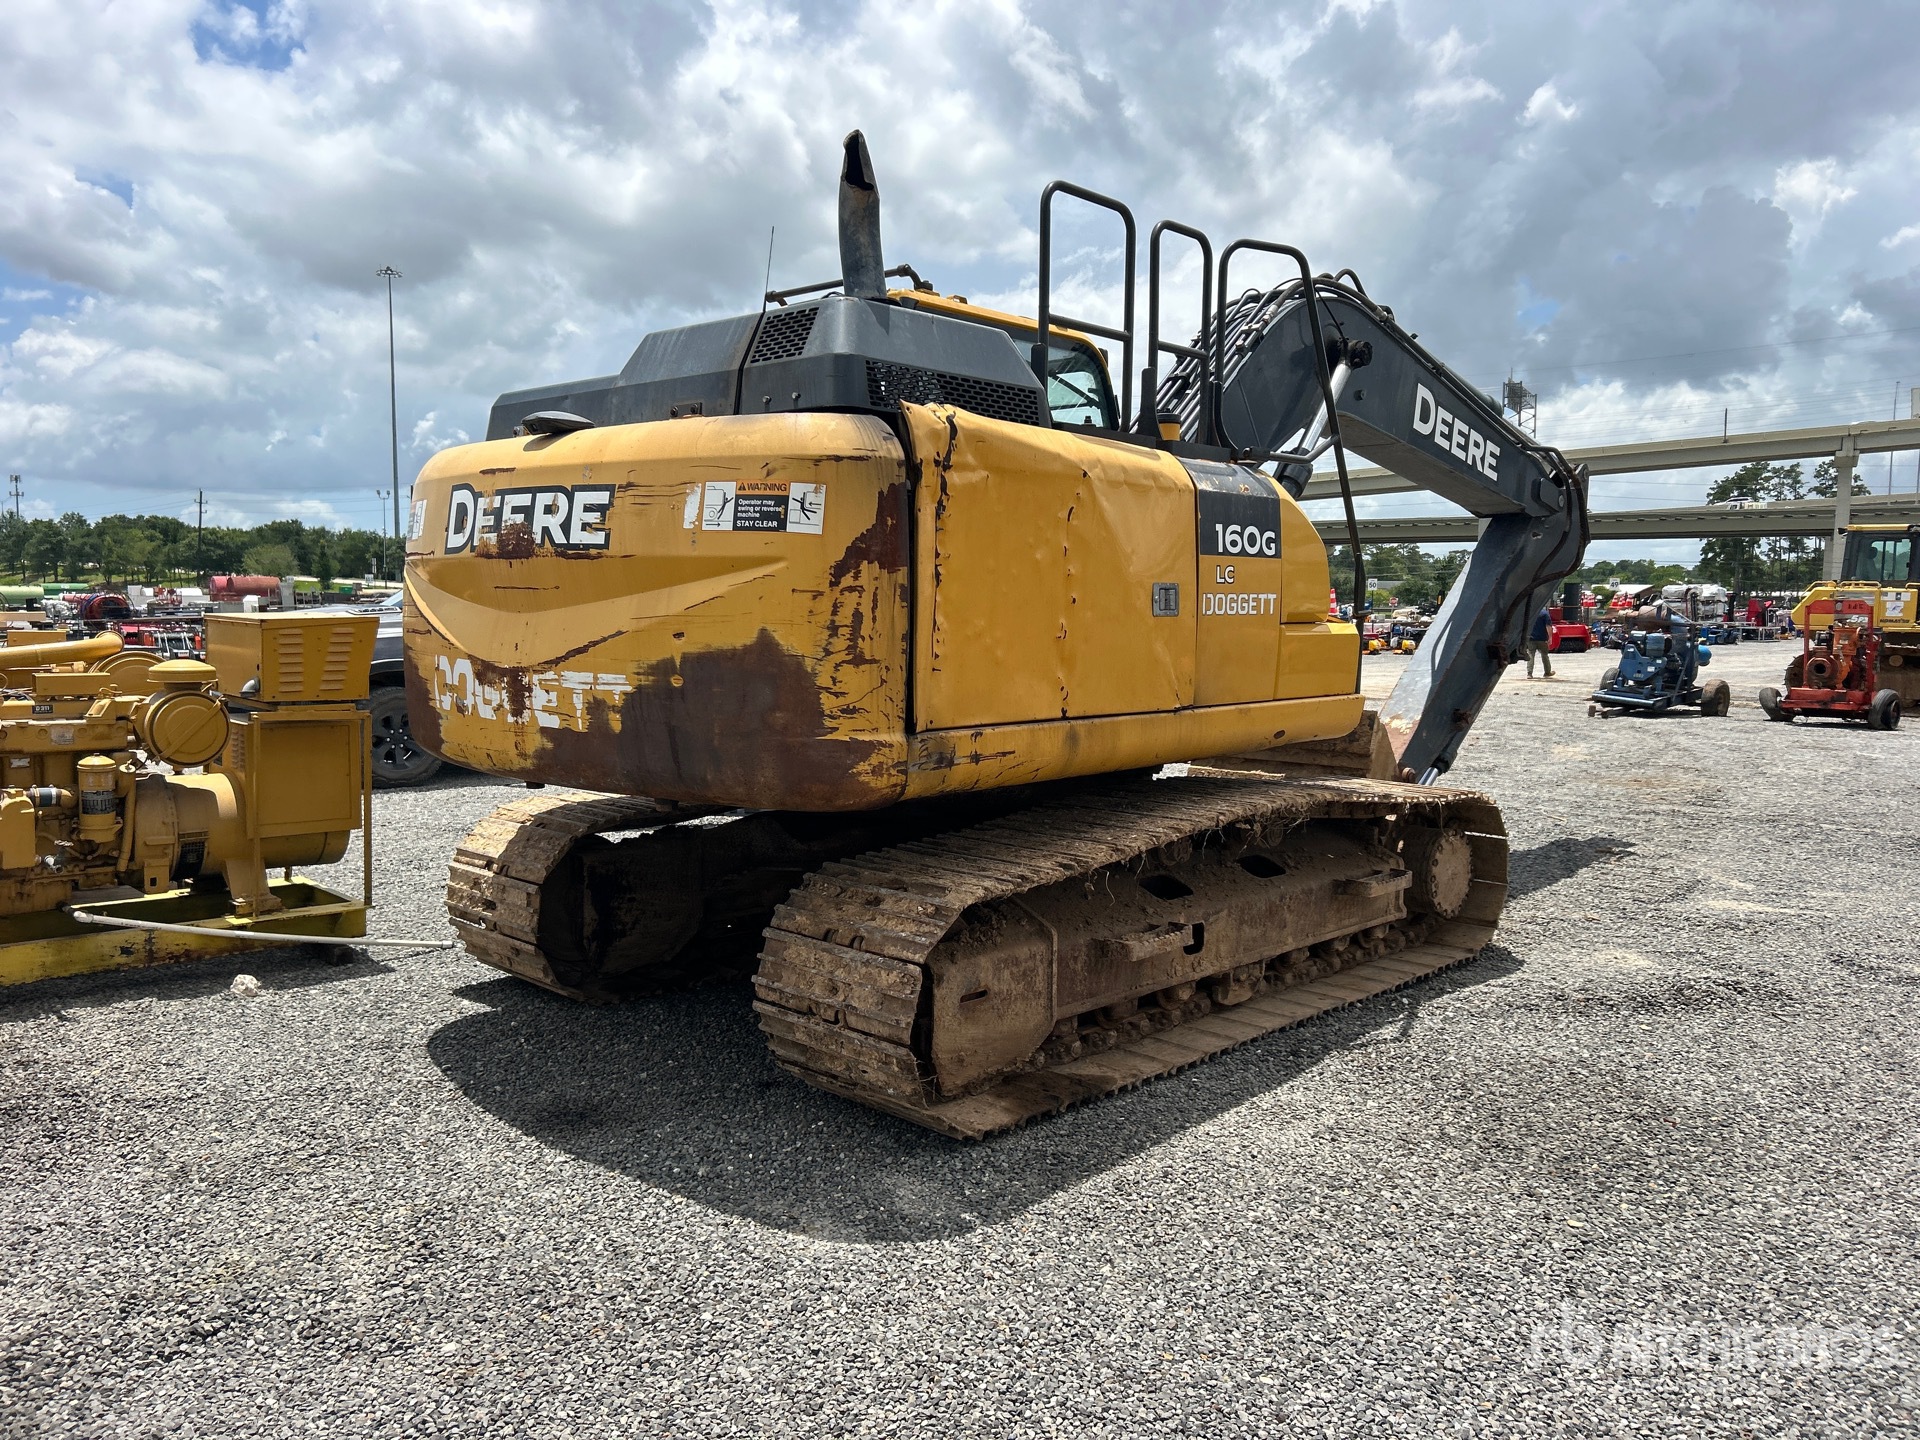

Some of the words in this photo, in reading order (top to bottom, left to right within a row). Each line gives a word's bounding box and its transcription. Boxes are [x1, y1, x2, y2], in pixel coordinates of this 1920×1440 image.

[1413, 383, 1501, 481] DEERE
[746, 482, 788, 492] WARNING
[738, 498, 762, 506] Operator
[1215, 523, 1276, 556] 160G
[1215, 565, 1235, 584] LC
[1202, 593, 1277, 615] DOGGETT
